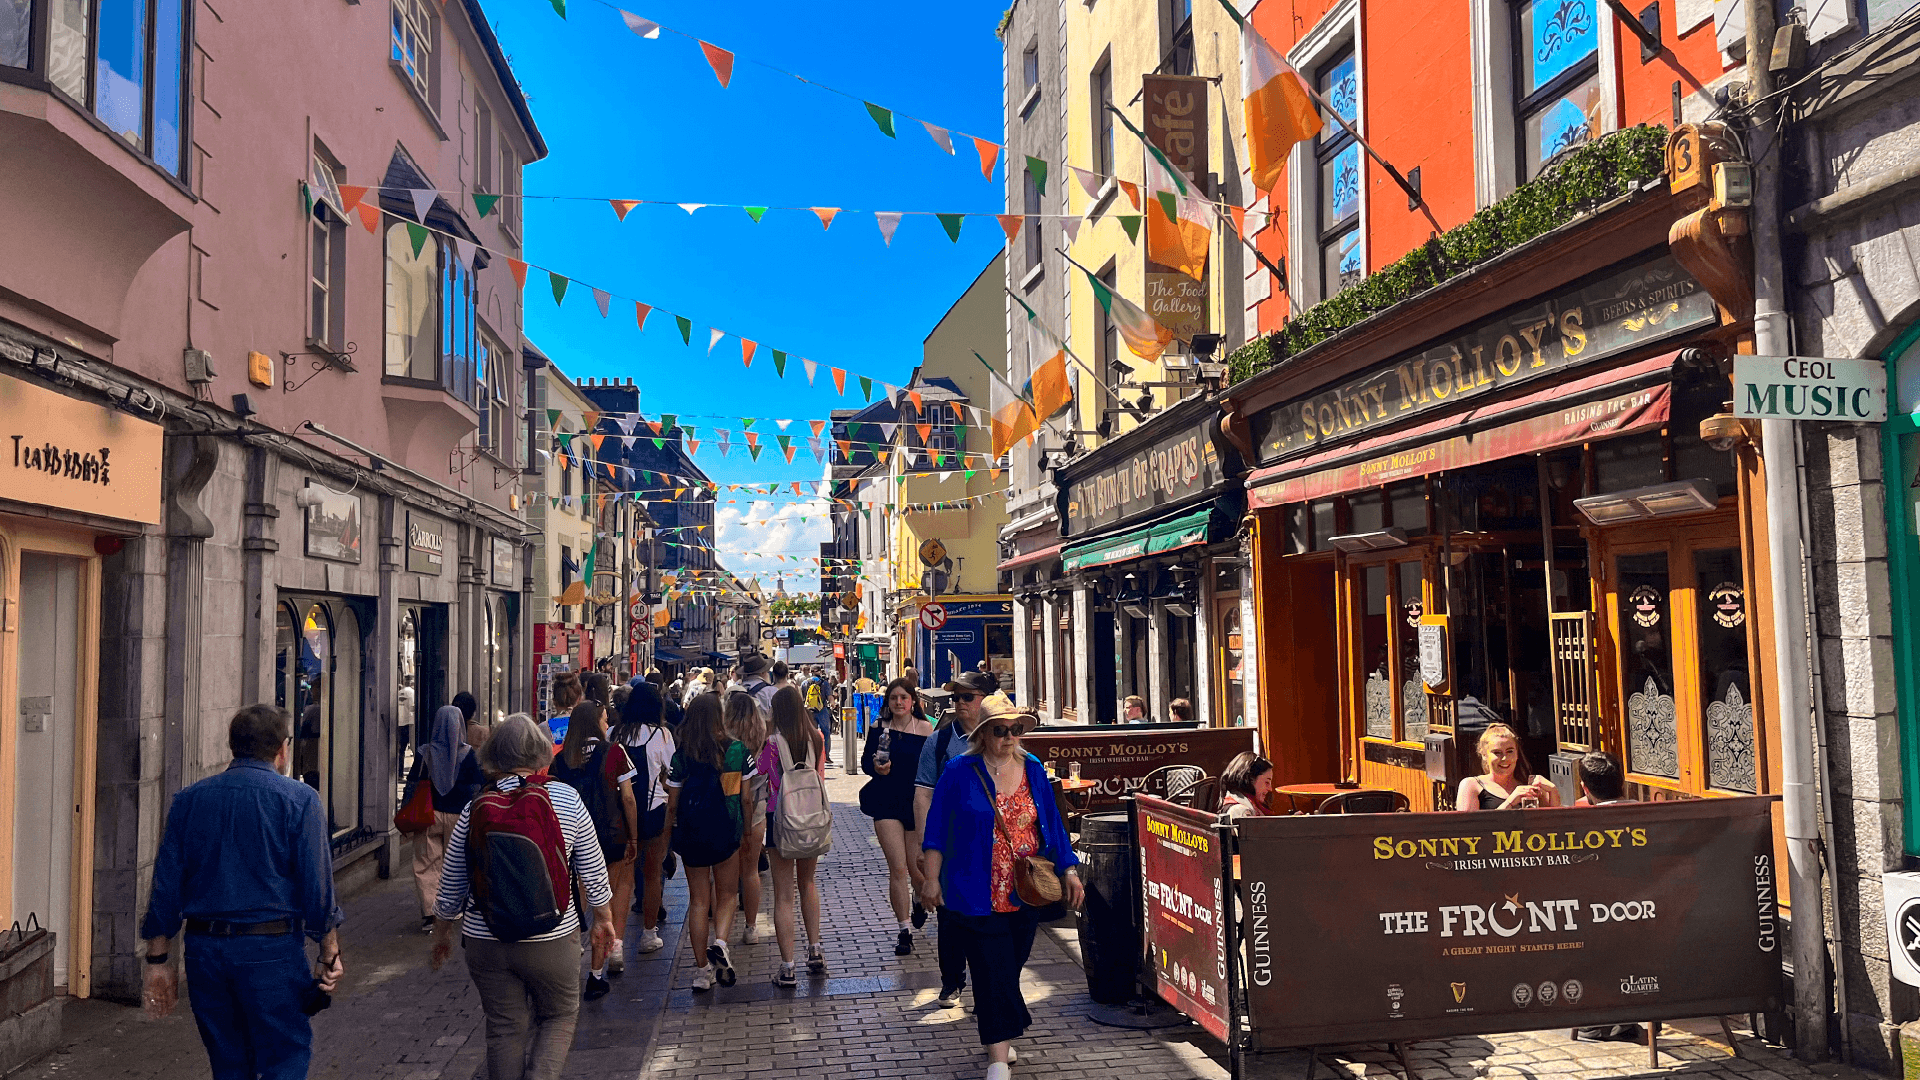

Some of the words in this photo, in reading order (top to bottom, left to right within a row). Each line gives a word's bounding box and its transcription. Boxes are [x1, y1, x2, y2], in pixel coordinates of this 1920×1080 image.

[1677, 138, 1692, 173] 3
[1148, 278, 1175, 297] The
[1178, 281, 1207, 297] Food
[1602, 299, 1636, 322] BEERS
[1638, 297, 1647, 309] &
[1648, 278, 1695, 305] SPIRITS
[1153, 297, 1202, 320] Gallery
[1301, 382, 1388, 442] SONNY
[1395, 306, 1588, 412] MOLLOY'S
[1783, 357, 1836, 380] CEOL
[1564, 404, 1603, 426] RAISING
[1607, 398, 1626, 415] THE
[1630, 393, 1651, 409] BAR
[1744, 383, 1871, 418] MUSIC
[1150, 436, 1199, 497] GRAPES
[1360, 460, 1389, 476] SONNY
[1390, 448, 1436, 470] MOLLOY'S
[410, 523, 442, 551] CARROLLS
[634, 605, 645, 615] 20
[1048, 746, 1104, 759] SONNY
[1109, 742, 1189, 756] MOLLOY'S
[1146, 815, 1170, 840] SONNY
[1372, 836, 1482, 860] SONNY
[1492, 827, 1648, 854] MOLLOY'S
[1454, 858, 1487, 871] IRISH
[1488, 856, 1544, 869] WHISKEY
[1546, 854, 1571, 866] BAR
[1148, 880, 1160, 900] THE
[1160, 882, 1193, 919] FRONT
[1194, 903, 1213, 926] DOOR
[1754, 854, 1776, 953] GUINNESS
[1214, 877, 1226, 980] GUINNESS
[1250, 880, 1272, 987] GUINNESS
[1379, 911, 1429, 935] THE
[1438, 899, 1580, 938] FRONT
[1589, 900, 1657, 924] DOOR
[1442, 948, 1450, 956] A
[1450, 946, 1484, 956] GREAT
[1485, 945, 1517, 954] NIGHT
[1519, 943, 1555, 953] STARTS
[1556, 941, 1585, 951] HERE!
[1620, 982, 1659, 994] QUARTER
[1629, 975, 1658, 985] LATIN
